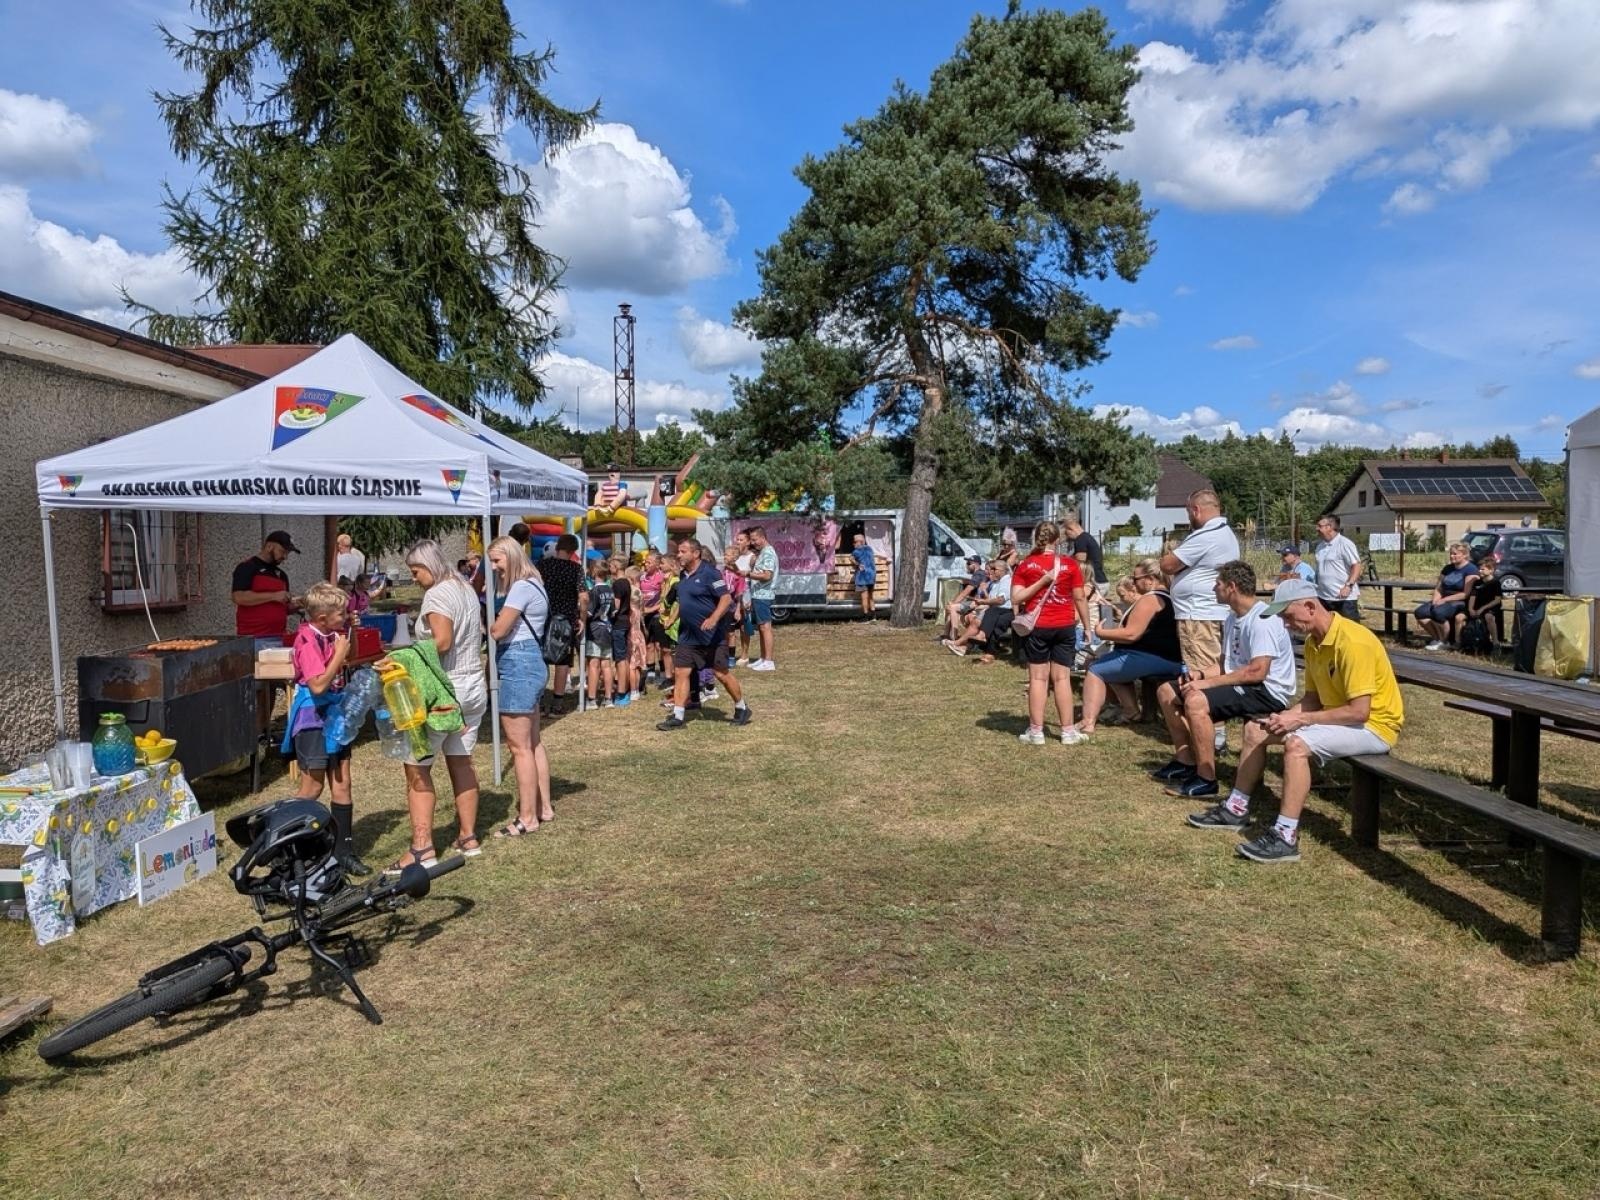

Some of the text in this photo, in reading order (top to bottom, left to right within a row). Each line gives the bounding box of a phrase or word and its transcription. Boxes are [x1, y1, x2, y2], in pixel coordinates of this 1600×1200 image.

[101, 475, 422, 499] AKADEMIA PIŁKARSKA GÓRKI ŚLĄSKIE
